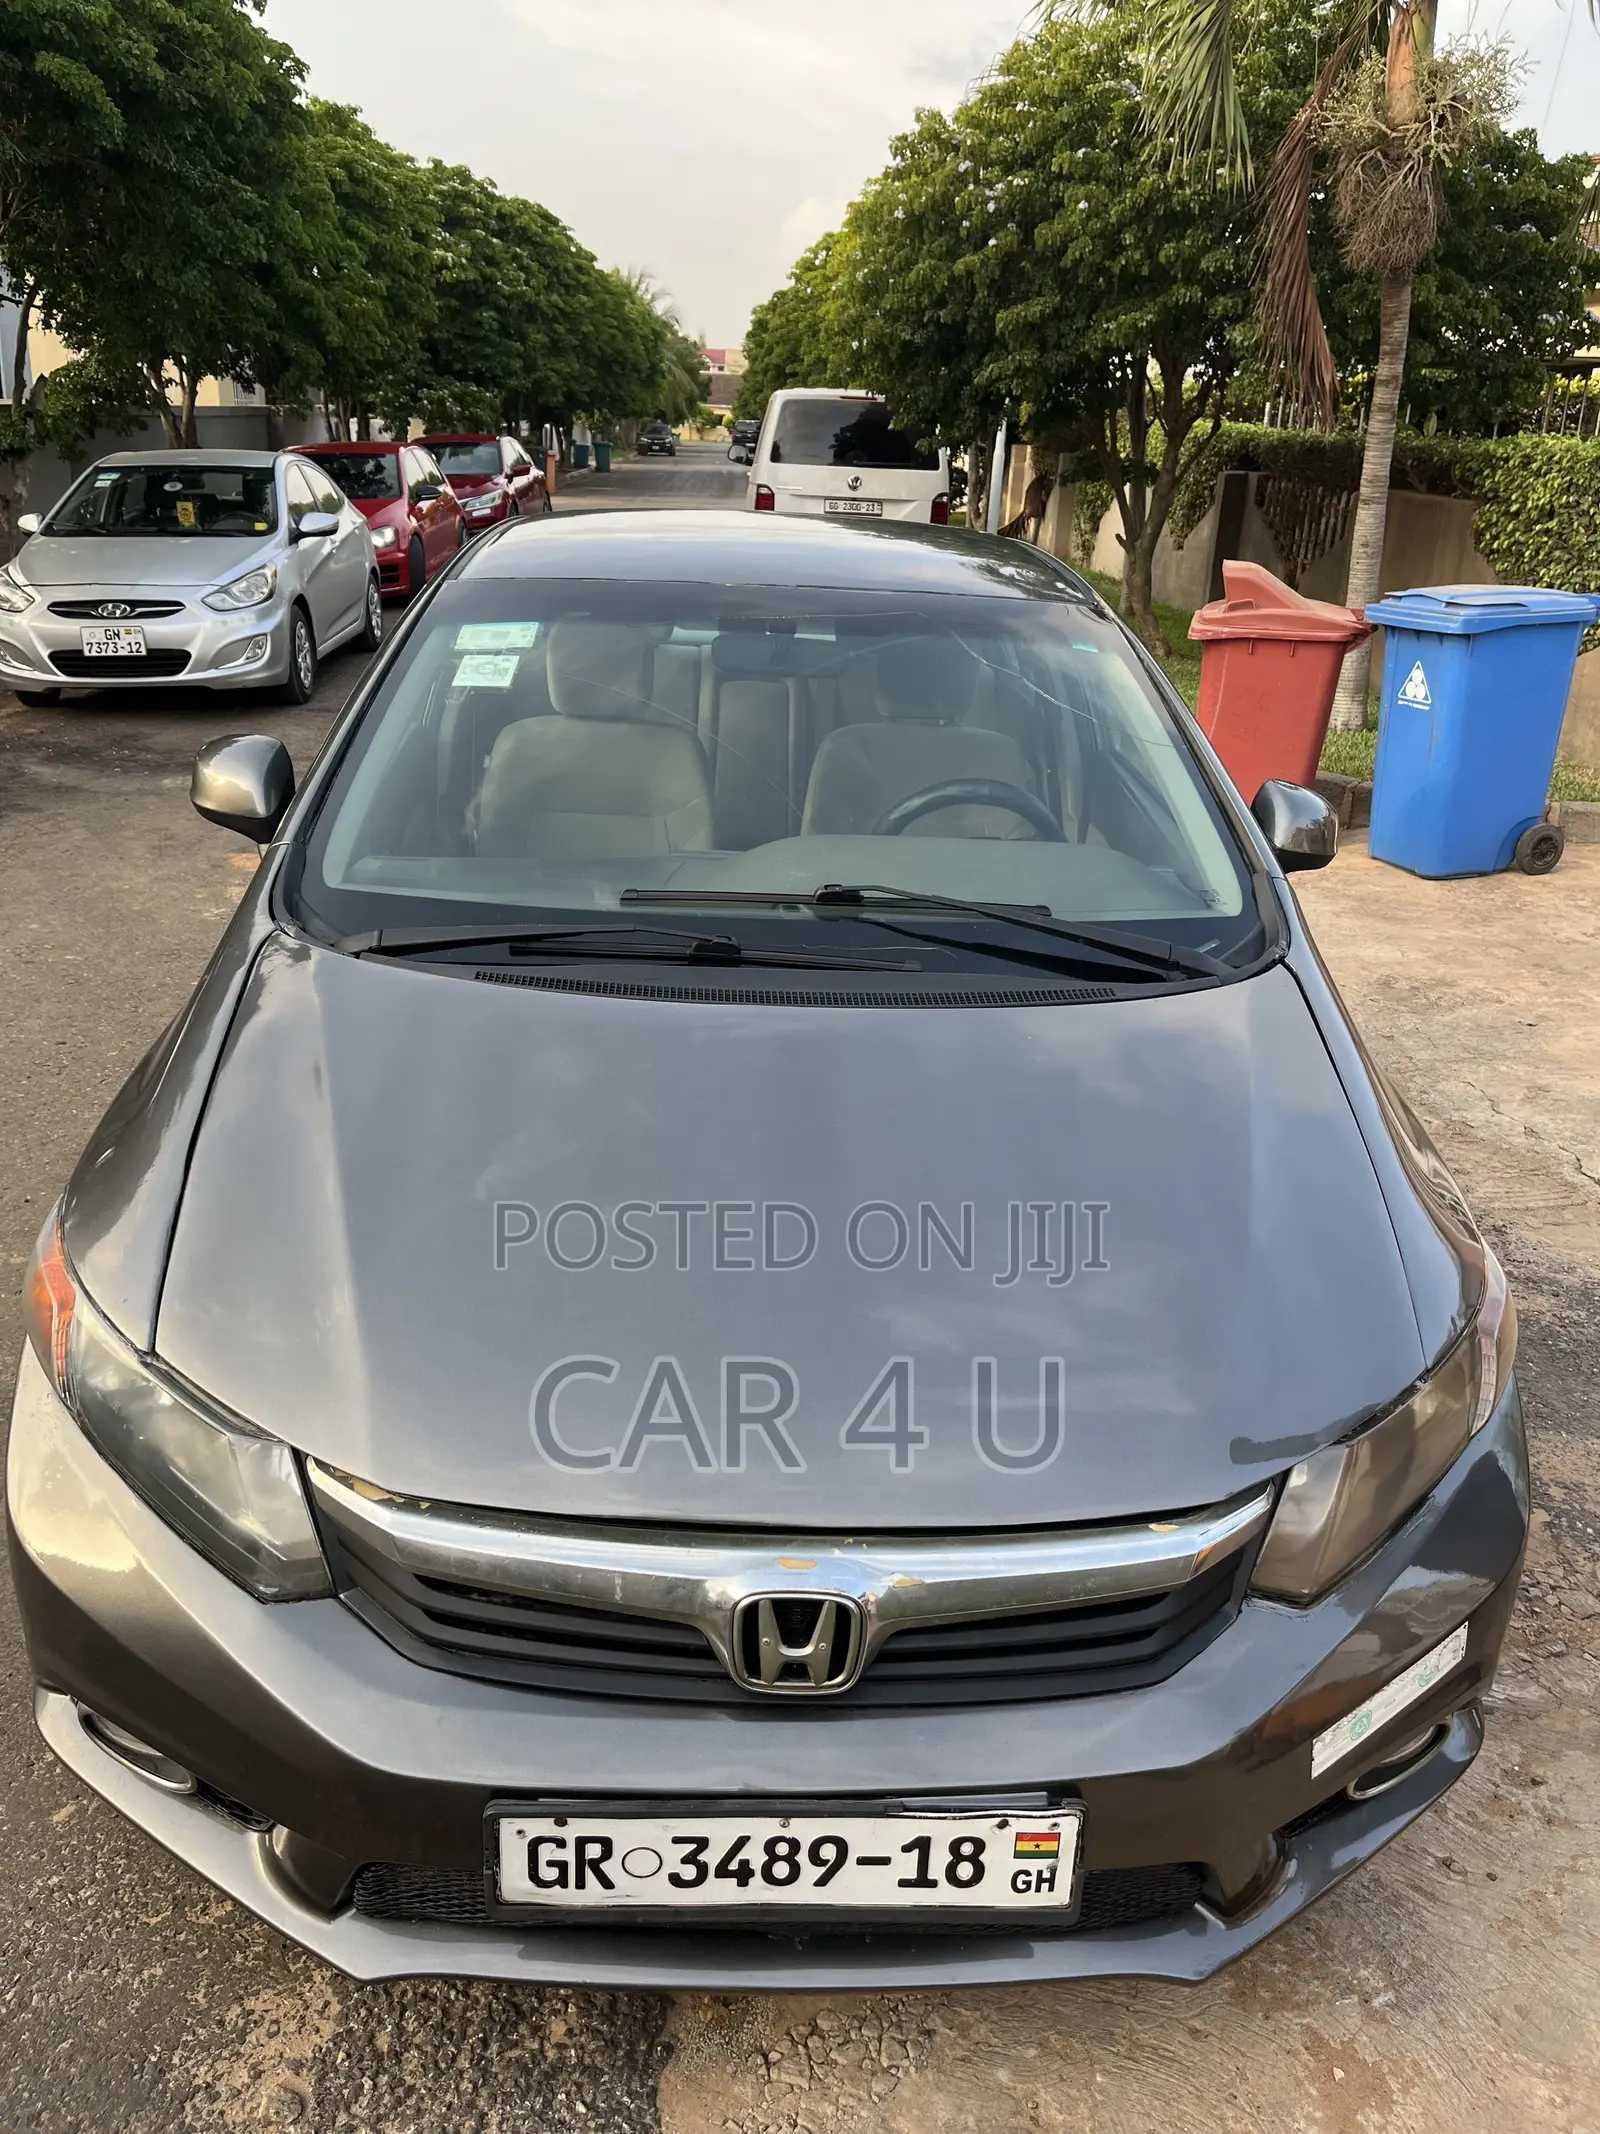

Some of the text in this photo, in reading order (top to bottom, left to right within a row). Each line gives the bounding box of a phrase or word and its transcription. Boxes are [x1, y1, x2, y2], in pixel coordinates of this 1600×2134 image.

[104, 629, 121, 641] GN
[86, 641, 143, 654] 7373-12
[527, 1834, 986, 1890] GR 3489-18
[1010, 1868, 1056, 1894] GH
